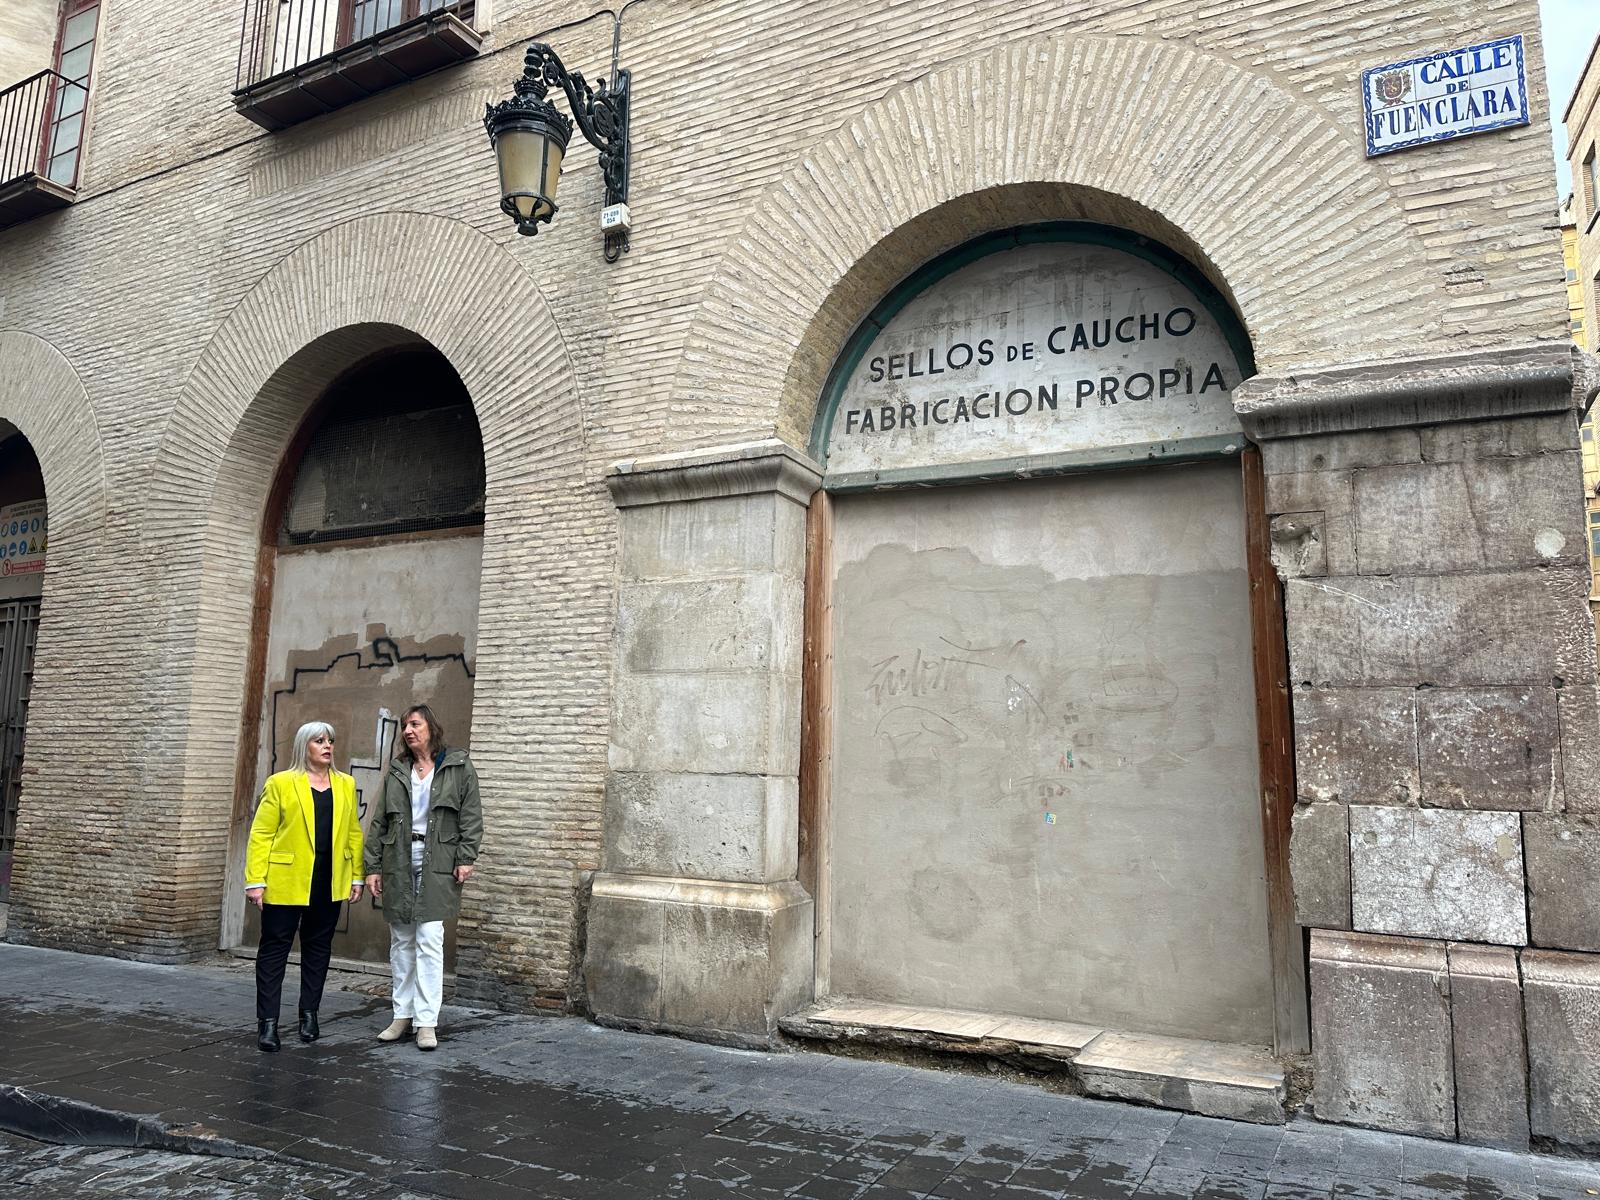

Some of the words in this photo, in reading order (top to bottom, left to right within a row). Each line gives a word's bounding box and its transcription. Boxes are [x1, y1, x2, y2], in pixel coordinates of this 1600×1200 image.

[1420, 45, 1512, 84] CALLE
[1446, 80, 1469, 95] DE
[1373, 86, 1517, 139] FUENCLARA
[870, 339, 994, 382] SELLOS
[1007, 342, 1034, 362] DE
[1047, 307, 1196, 354] CAUCHO
[845, 384, 1058, 434] FABRICACION
[1076, 362, 1228, 408] PROPIA
